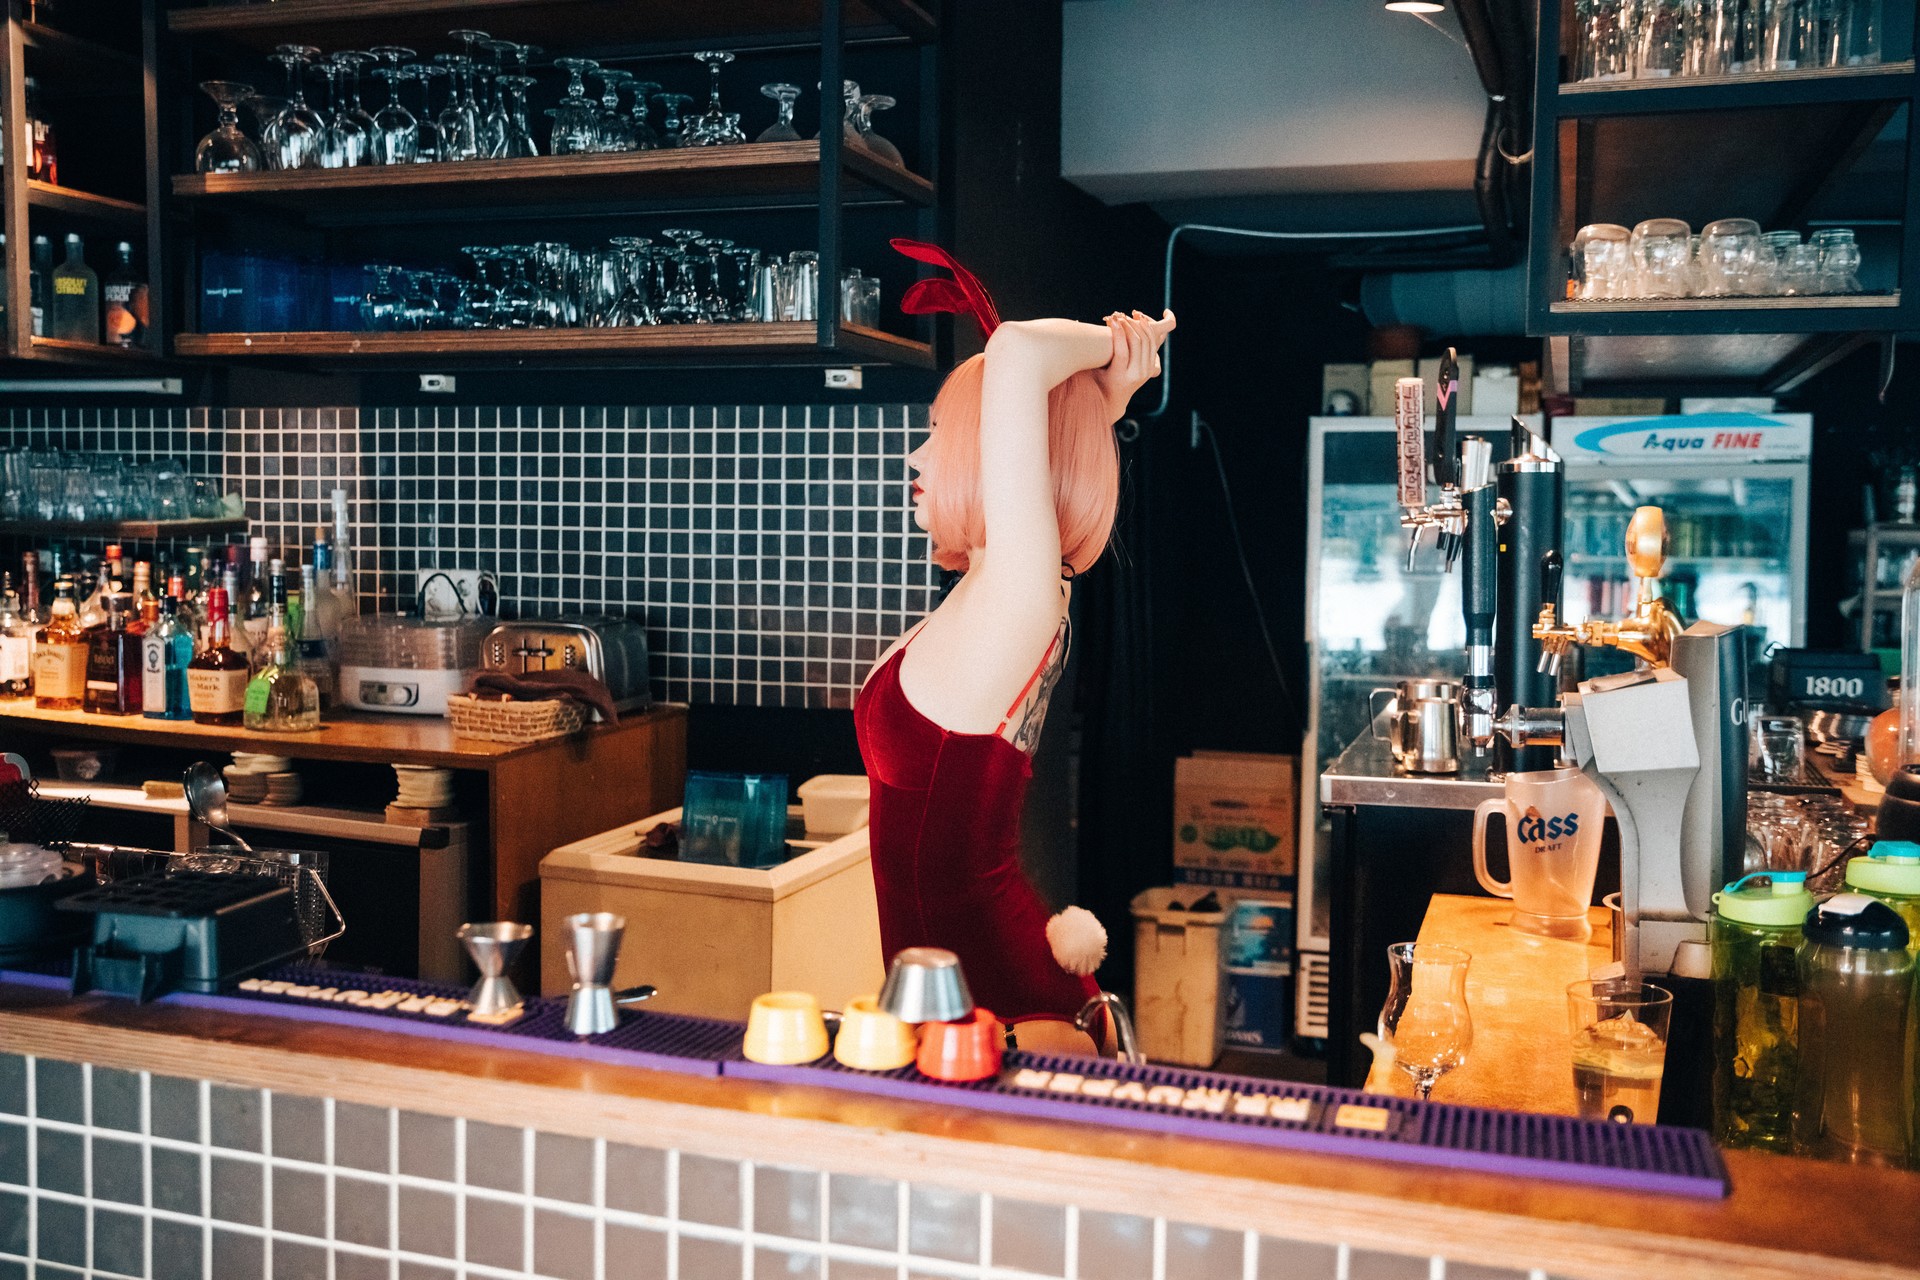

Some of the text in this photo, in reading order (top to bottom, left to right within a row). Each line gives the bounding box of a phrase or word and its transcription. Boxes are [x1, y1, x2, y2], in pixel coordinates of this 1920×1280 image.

[1643, 433, 1762, 451] Aqua FINE
[1806, 676, 1864, 697] 1800
[1517, 812, 1579, 844] Cass
[1534, 843, 1563, 854] DRAFT
